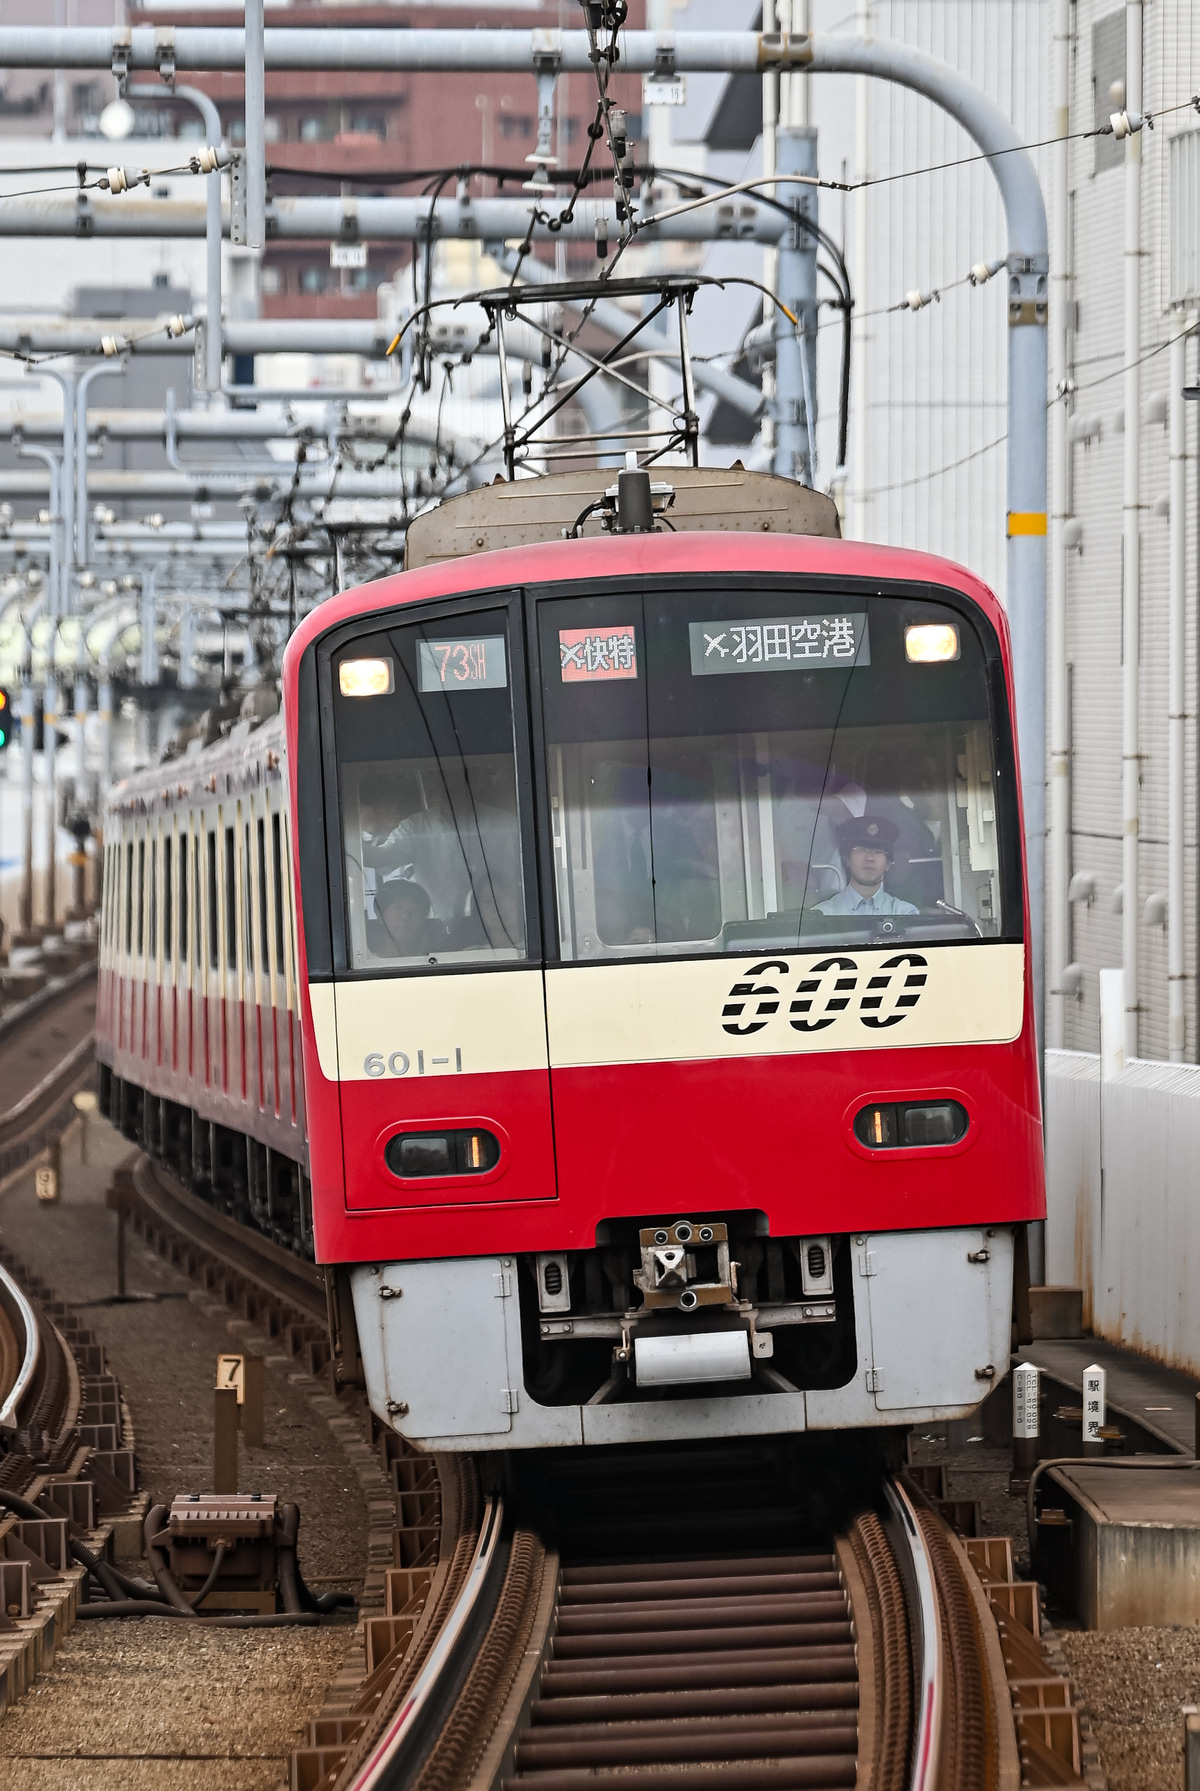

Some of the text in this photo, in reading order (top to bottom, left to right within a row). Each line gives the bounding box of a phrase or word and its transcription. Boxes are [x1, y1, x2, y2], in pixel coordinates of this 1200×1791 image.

[584, 634, 634, 672] 快特
[730, 618, 855, 663] 羽田空港
[722, 953, 928, 1036] 600
[364, 1047, 462, 1077] 601-1
[223, 1359, 241, 1382] 7
[1087, 1380, 1100, 1435] 駅境界
